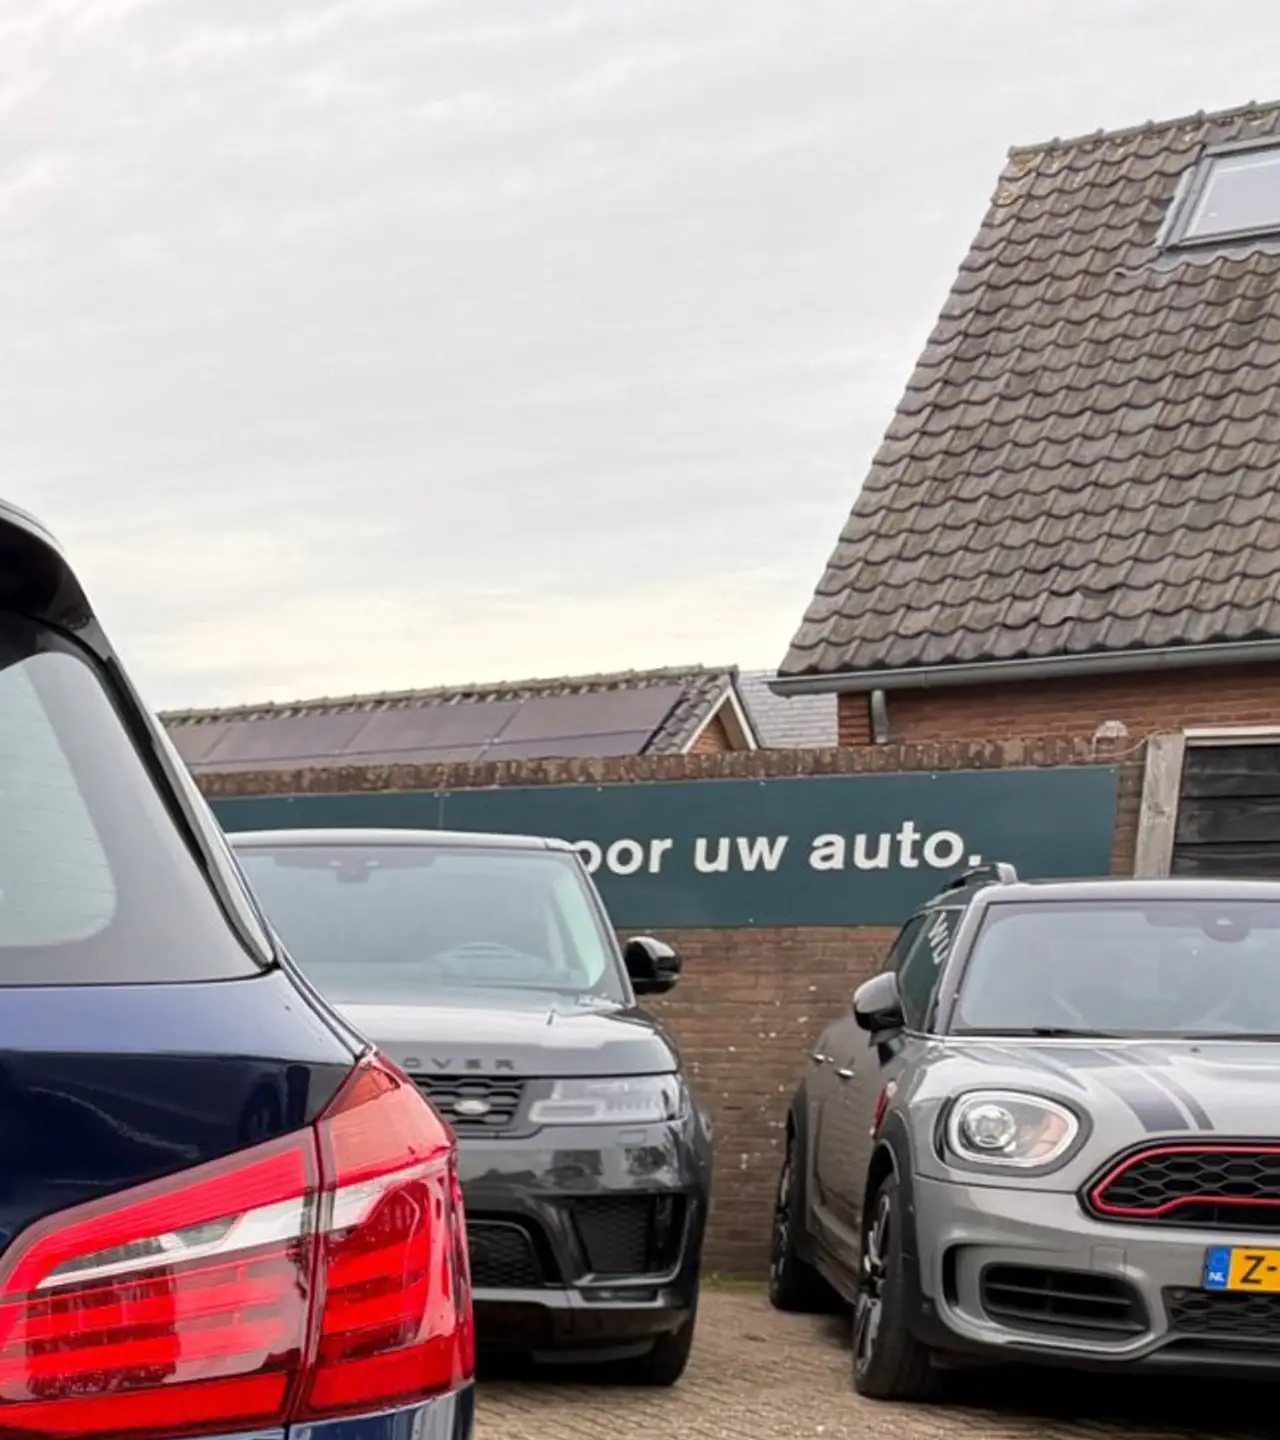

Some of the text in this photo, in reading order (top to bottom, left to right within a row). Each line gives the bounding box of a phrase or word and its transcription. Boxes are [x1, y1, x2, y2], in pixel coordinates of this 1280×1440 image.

[570, 821, 982, 875] oor uw auto.
[403, 1057, 516, 1071] OVER
